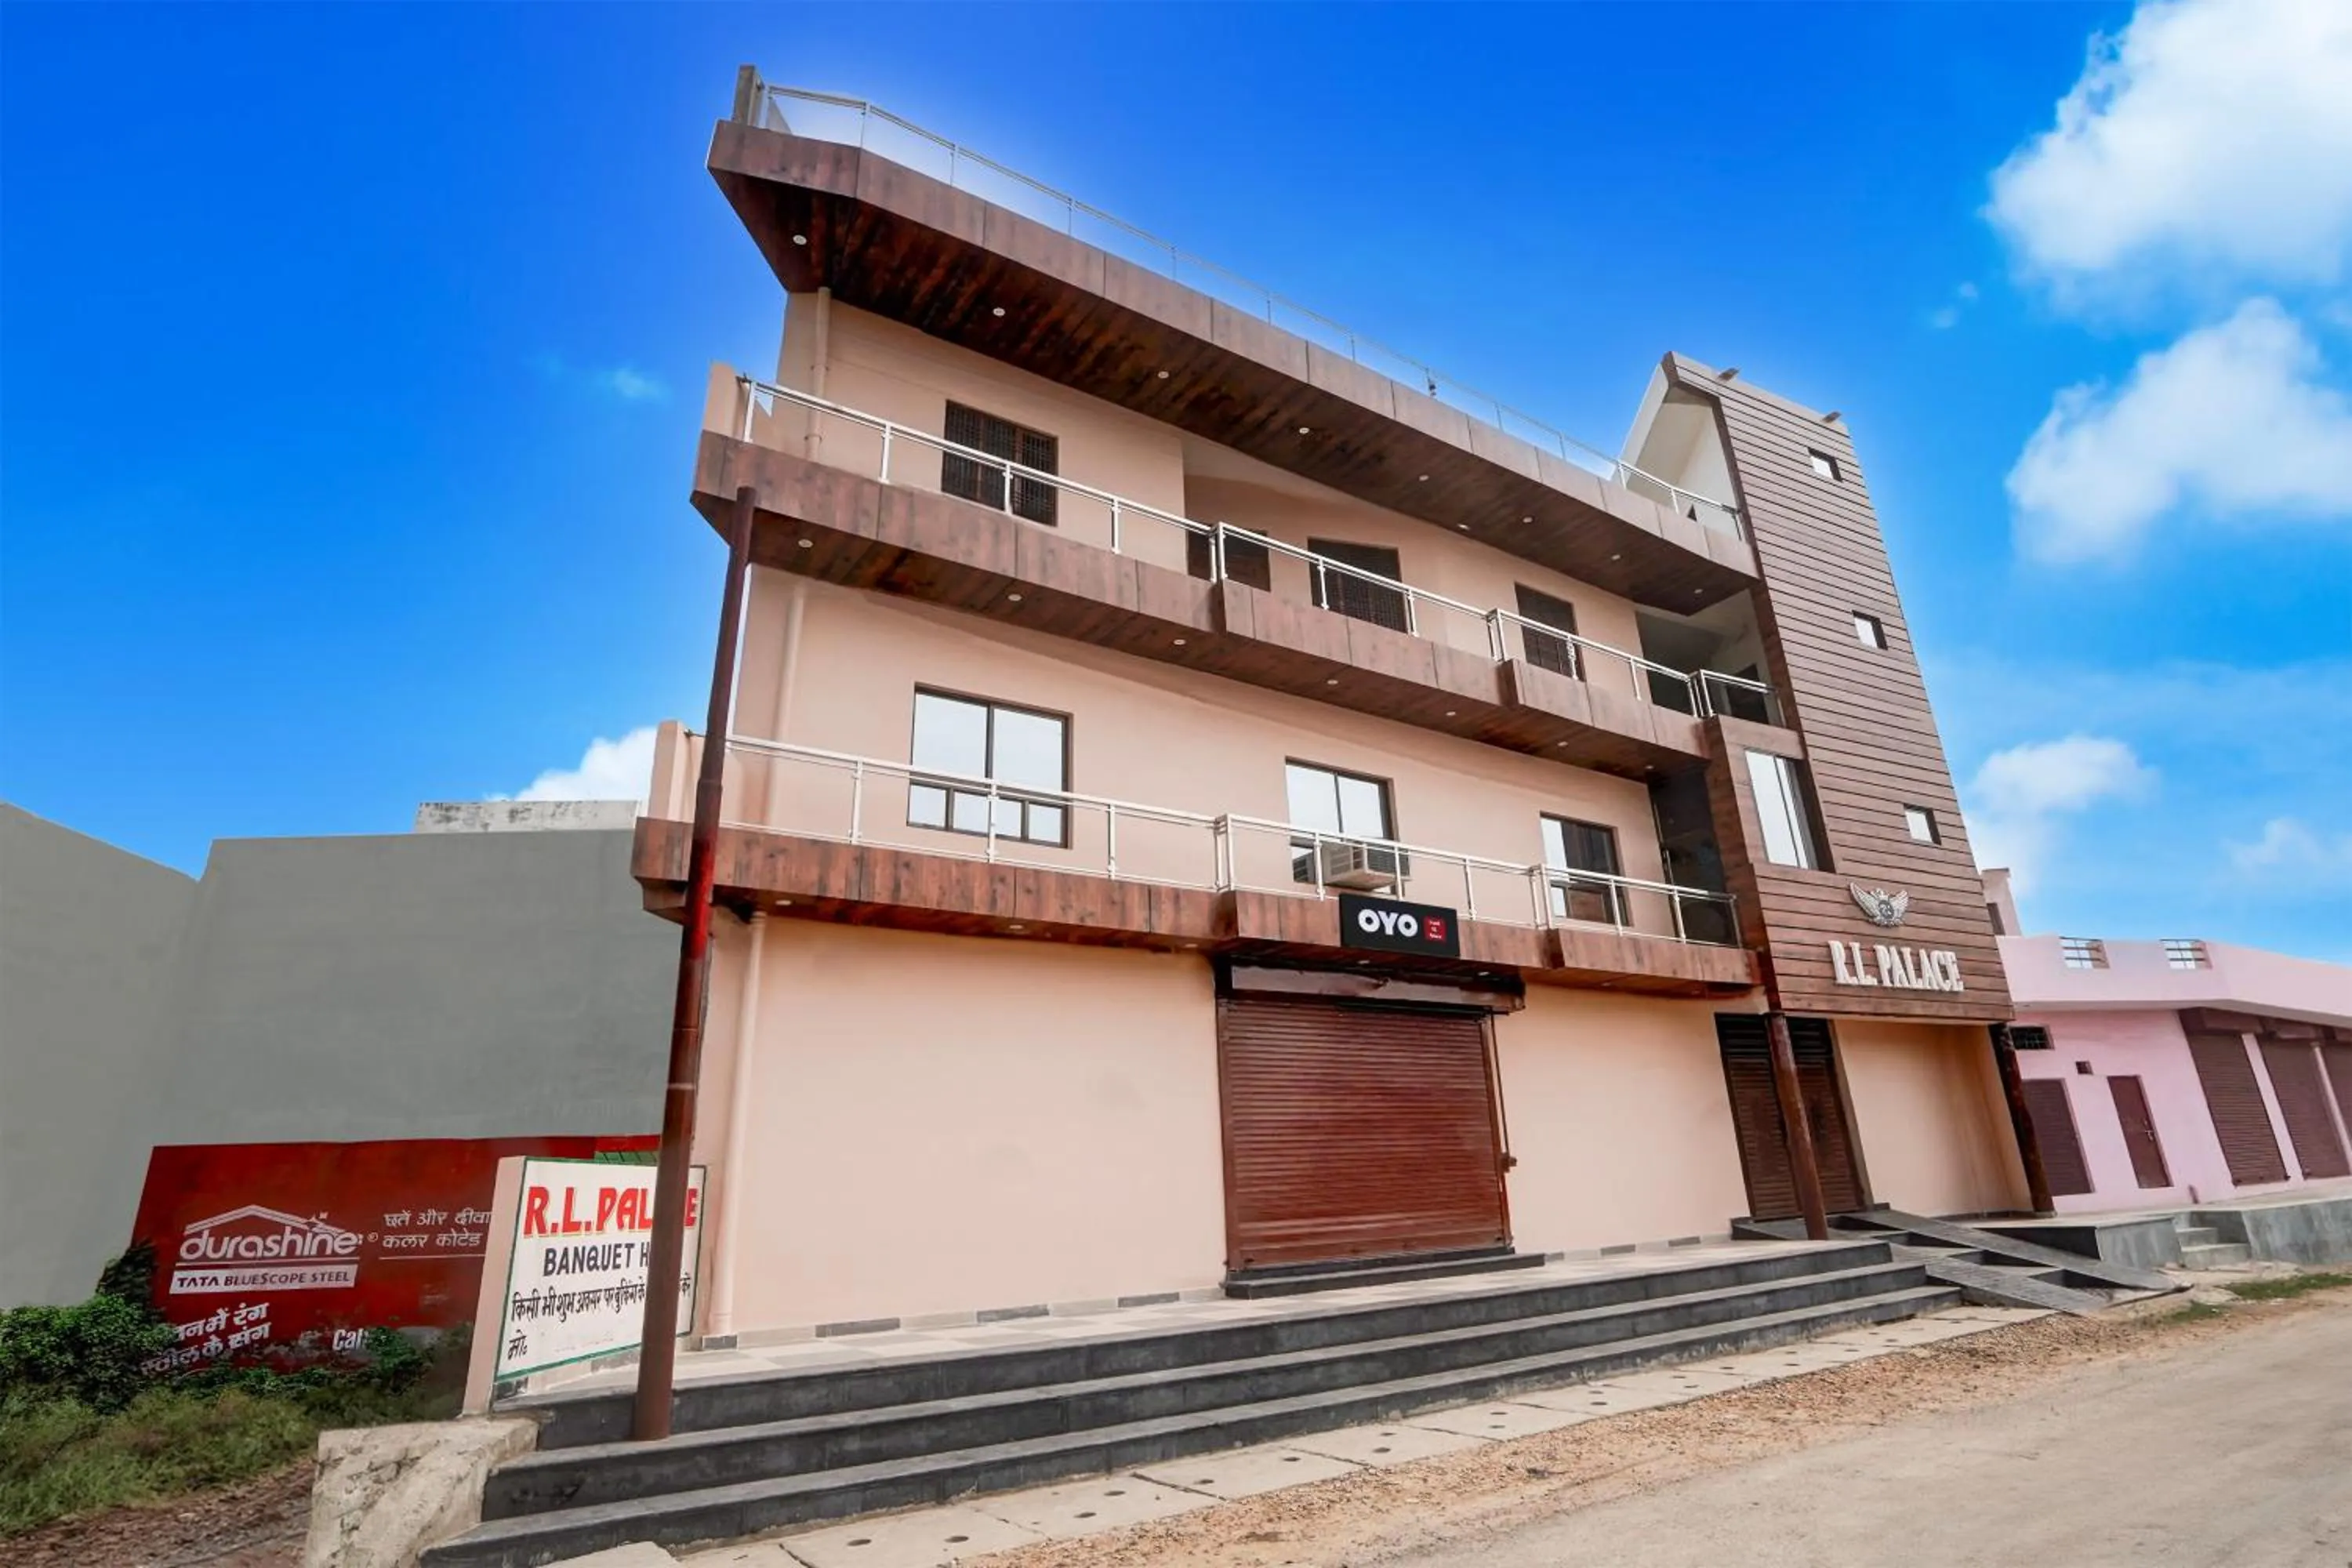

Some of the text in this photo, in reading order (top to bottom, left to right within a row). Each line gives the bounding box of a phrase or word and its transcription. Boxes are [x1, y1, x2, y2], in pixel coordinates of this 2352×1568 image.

[1358, 909, 1418, 937] OYO
[1873, 944, 1964, 992] PALACE
[416, 1207, 448, 1226] और
[455, 1207, 492, 1226] दीवा
[180, 1225, 359, 1260] durashine
[382, 1227, 484, 1249] कलर कोटेड
[543, 1243, 636, 1277] BANQUET
[176, 1276, 220, 1288] TATA
[311, 1270, 350, 1283] STEEL
[234, 1301, 270, 1326] रंग
[511, 1291, 541, 1322] किसी
[227, 1321, 273, 1349] संग
